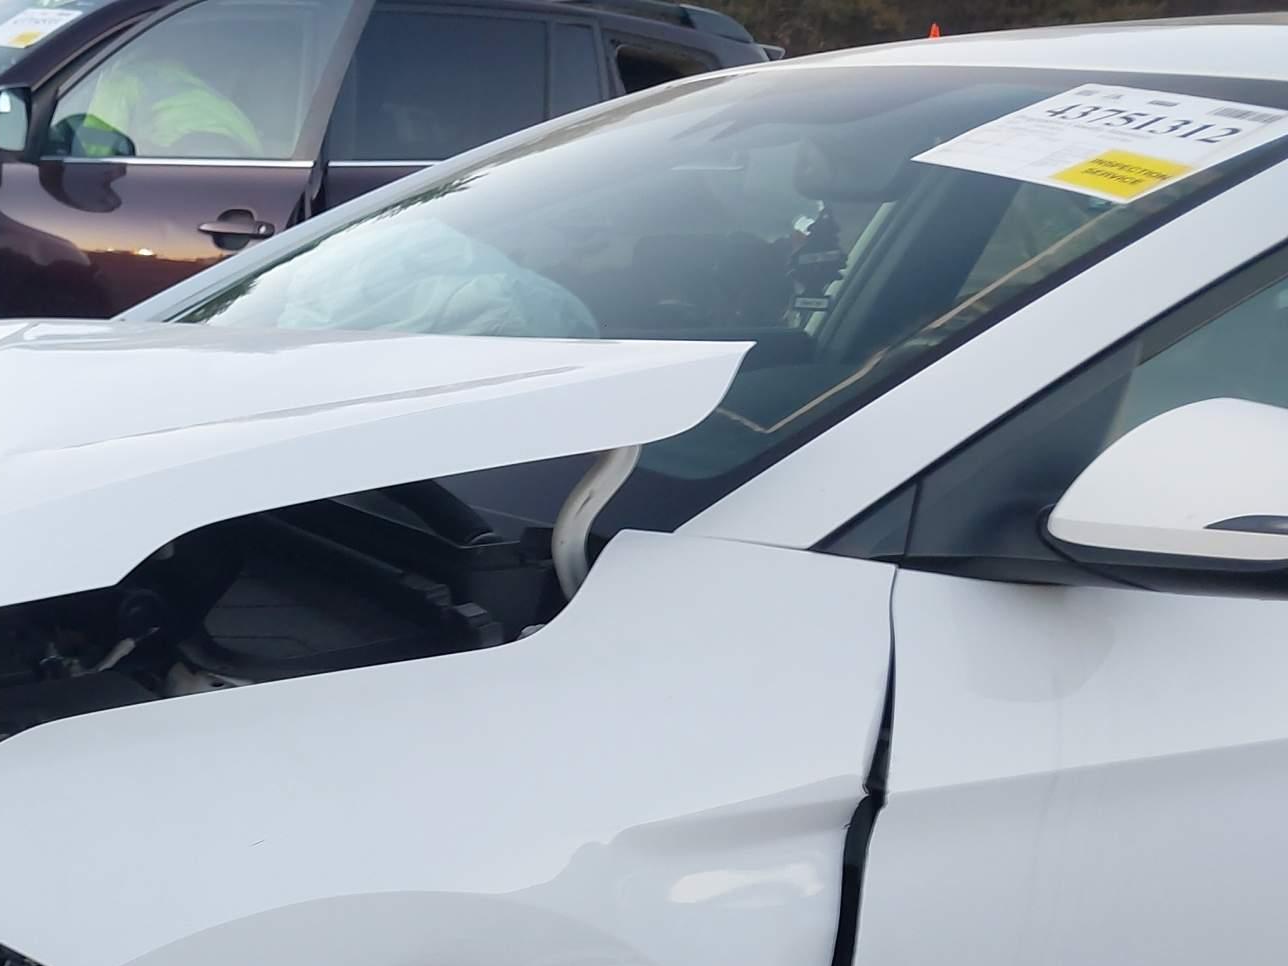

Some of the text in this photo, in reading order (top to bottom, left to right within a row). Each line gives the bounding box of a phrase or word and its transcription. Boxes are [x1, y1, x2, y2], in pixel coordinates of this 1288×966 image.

[1045, 103, 1242, 143] 43751312
[1081, 167, 1142, 185] SERVICE
[1090, 157, 1171, 180] INSPECTION
